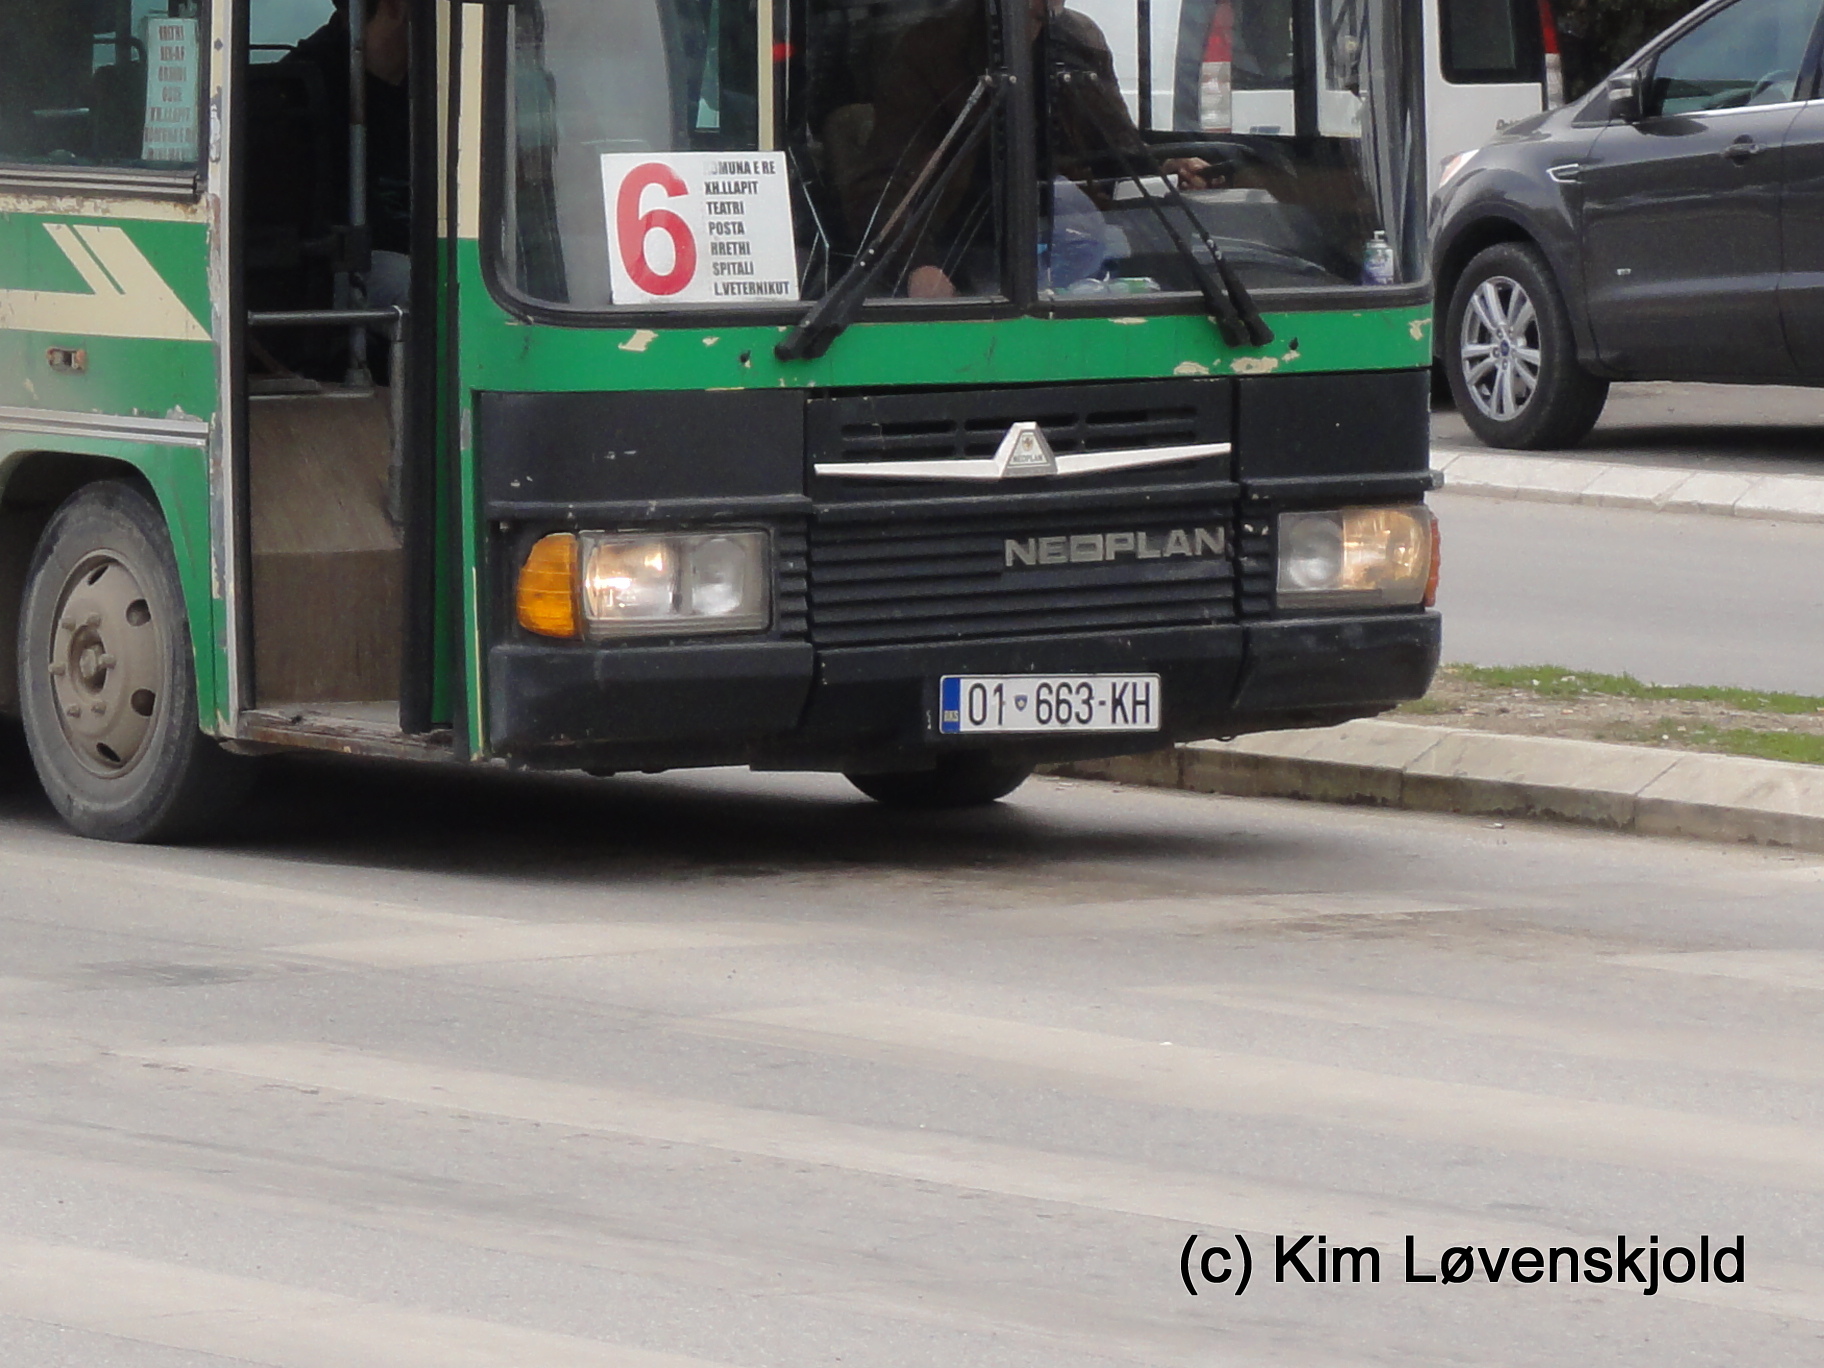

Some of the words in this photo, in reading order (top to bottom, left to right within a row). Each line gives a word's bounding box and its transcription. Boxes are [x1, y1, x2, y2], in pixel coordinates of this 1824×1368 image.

[754, 162, 759, 174] E
[762, 161, 775, 174] RE
[706, 201, 744, 215] TEATRI
[616, 162, 697, 296] 6
[708, 221, 745, 235] POSTA
[712, 262, 754, 276] SPITALI
[1013, 454, 1044, 463] NEOPLAN
[1005, 528, 1225, 567] NEOPLAN
[968, 682, 1004, 726] 01
[1035, 682, 1150, 725] 663-KH
